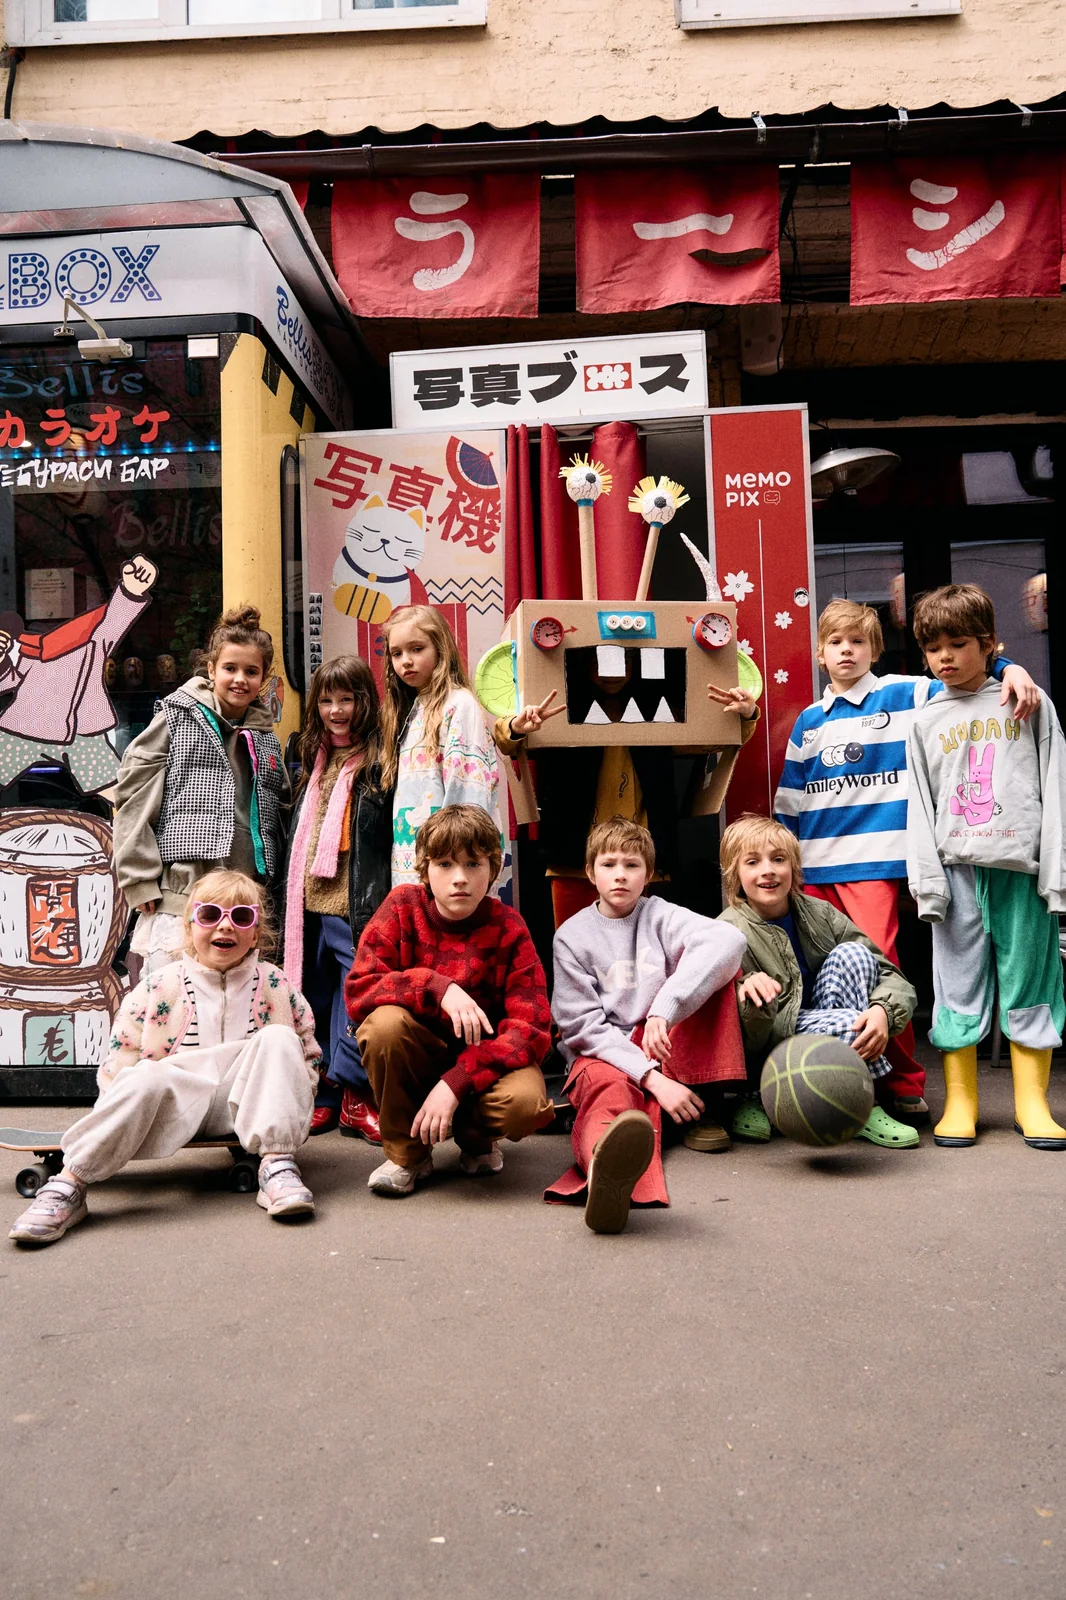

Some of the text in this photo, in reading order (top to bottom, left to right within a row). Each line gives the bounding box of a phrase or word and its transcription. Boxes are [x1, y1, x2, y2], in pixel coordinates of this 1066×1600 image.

[8, 244, 162, 309] BOX
[276, 285, 313, 366] Bellis
[413, 350, 691, 411] 写真ブス
[0, 404, 171, 447] カラオケ
[120, 455, 170, 483] БАР
[725, 490, 760, 507] PIX
[803, 768, 899, 795] mileyWorld
